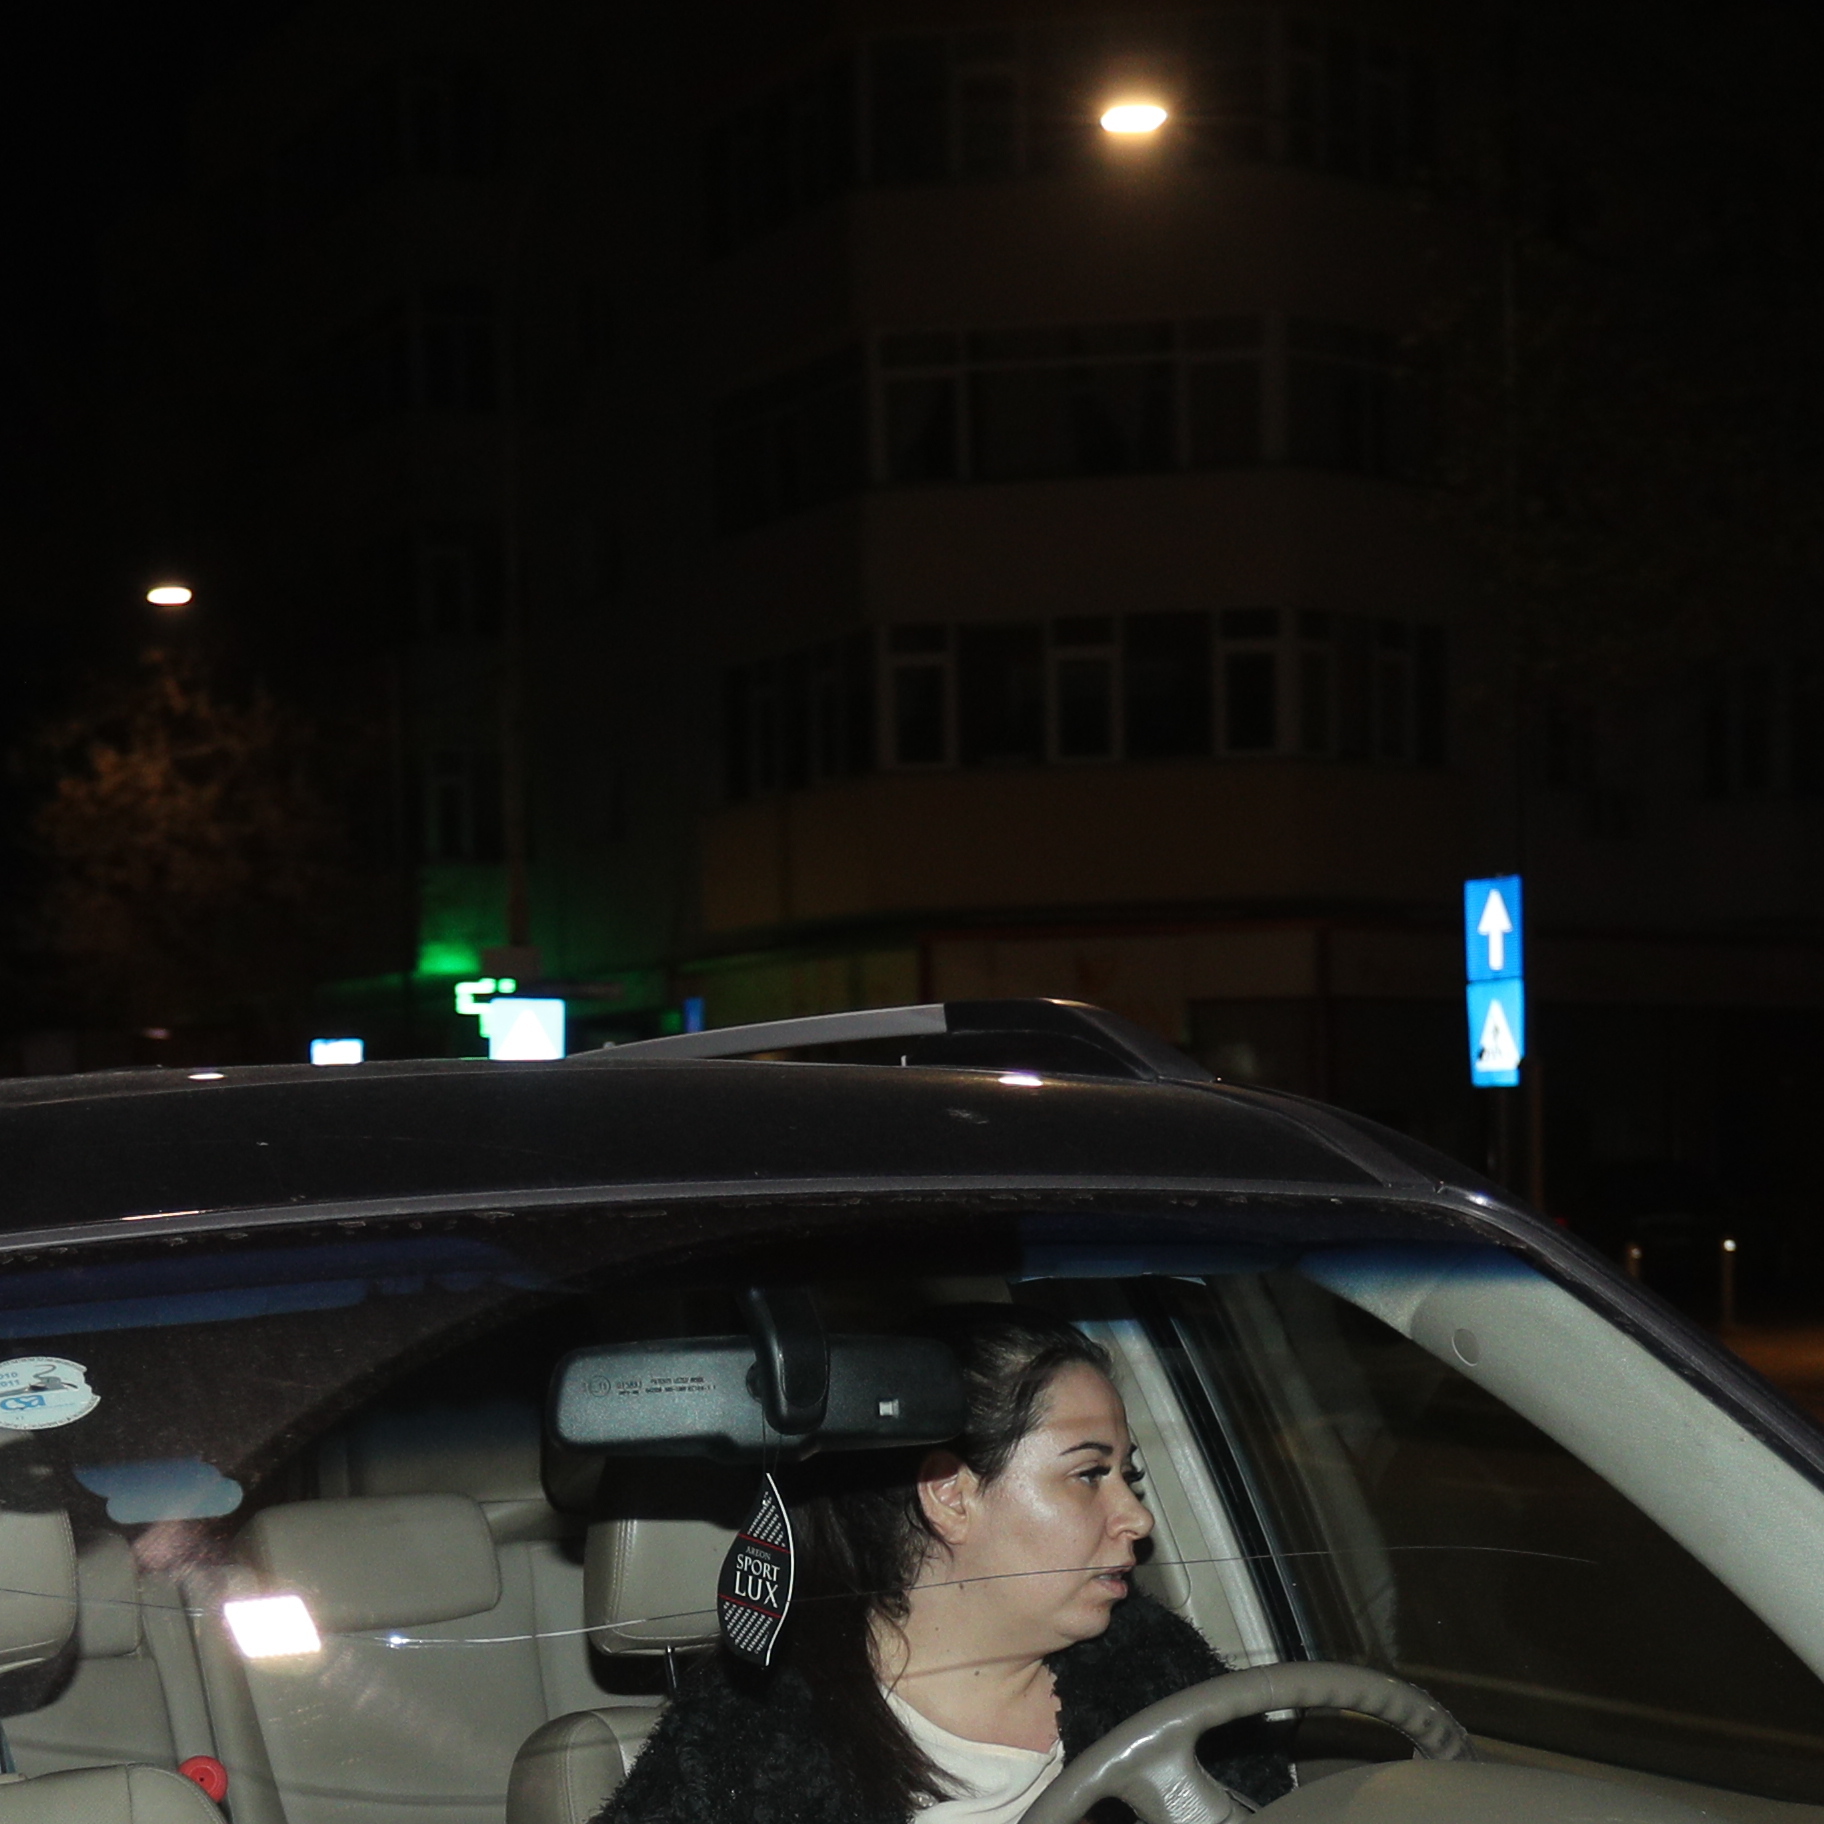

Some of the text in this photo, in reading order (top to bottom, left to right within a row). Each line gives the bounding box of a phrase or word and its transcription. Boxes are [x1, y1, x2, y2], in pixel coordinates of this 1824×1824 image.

[736, 1553, 780, 1581] SPORT
[745, 1546, 771, 1560] AREON
[735, 1570, 778, 1608] LUX
